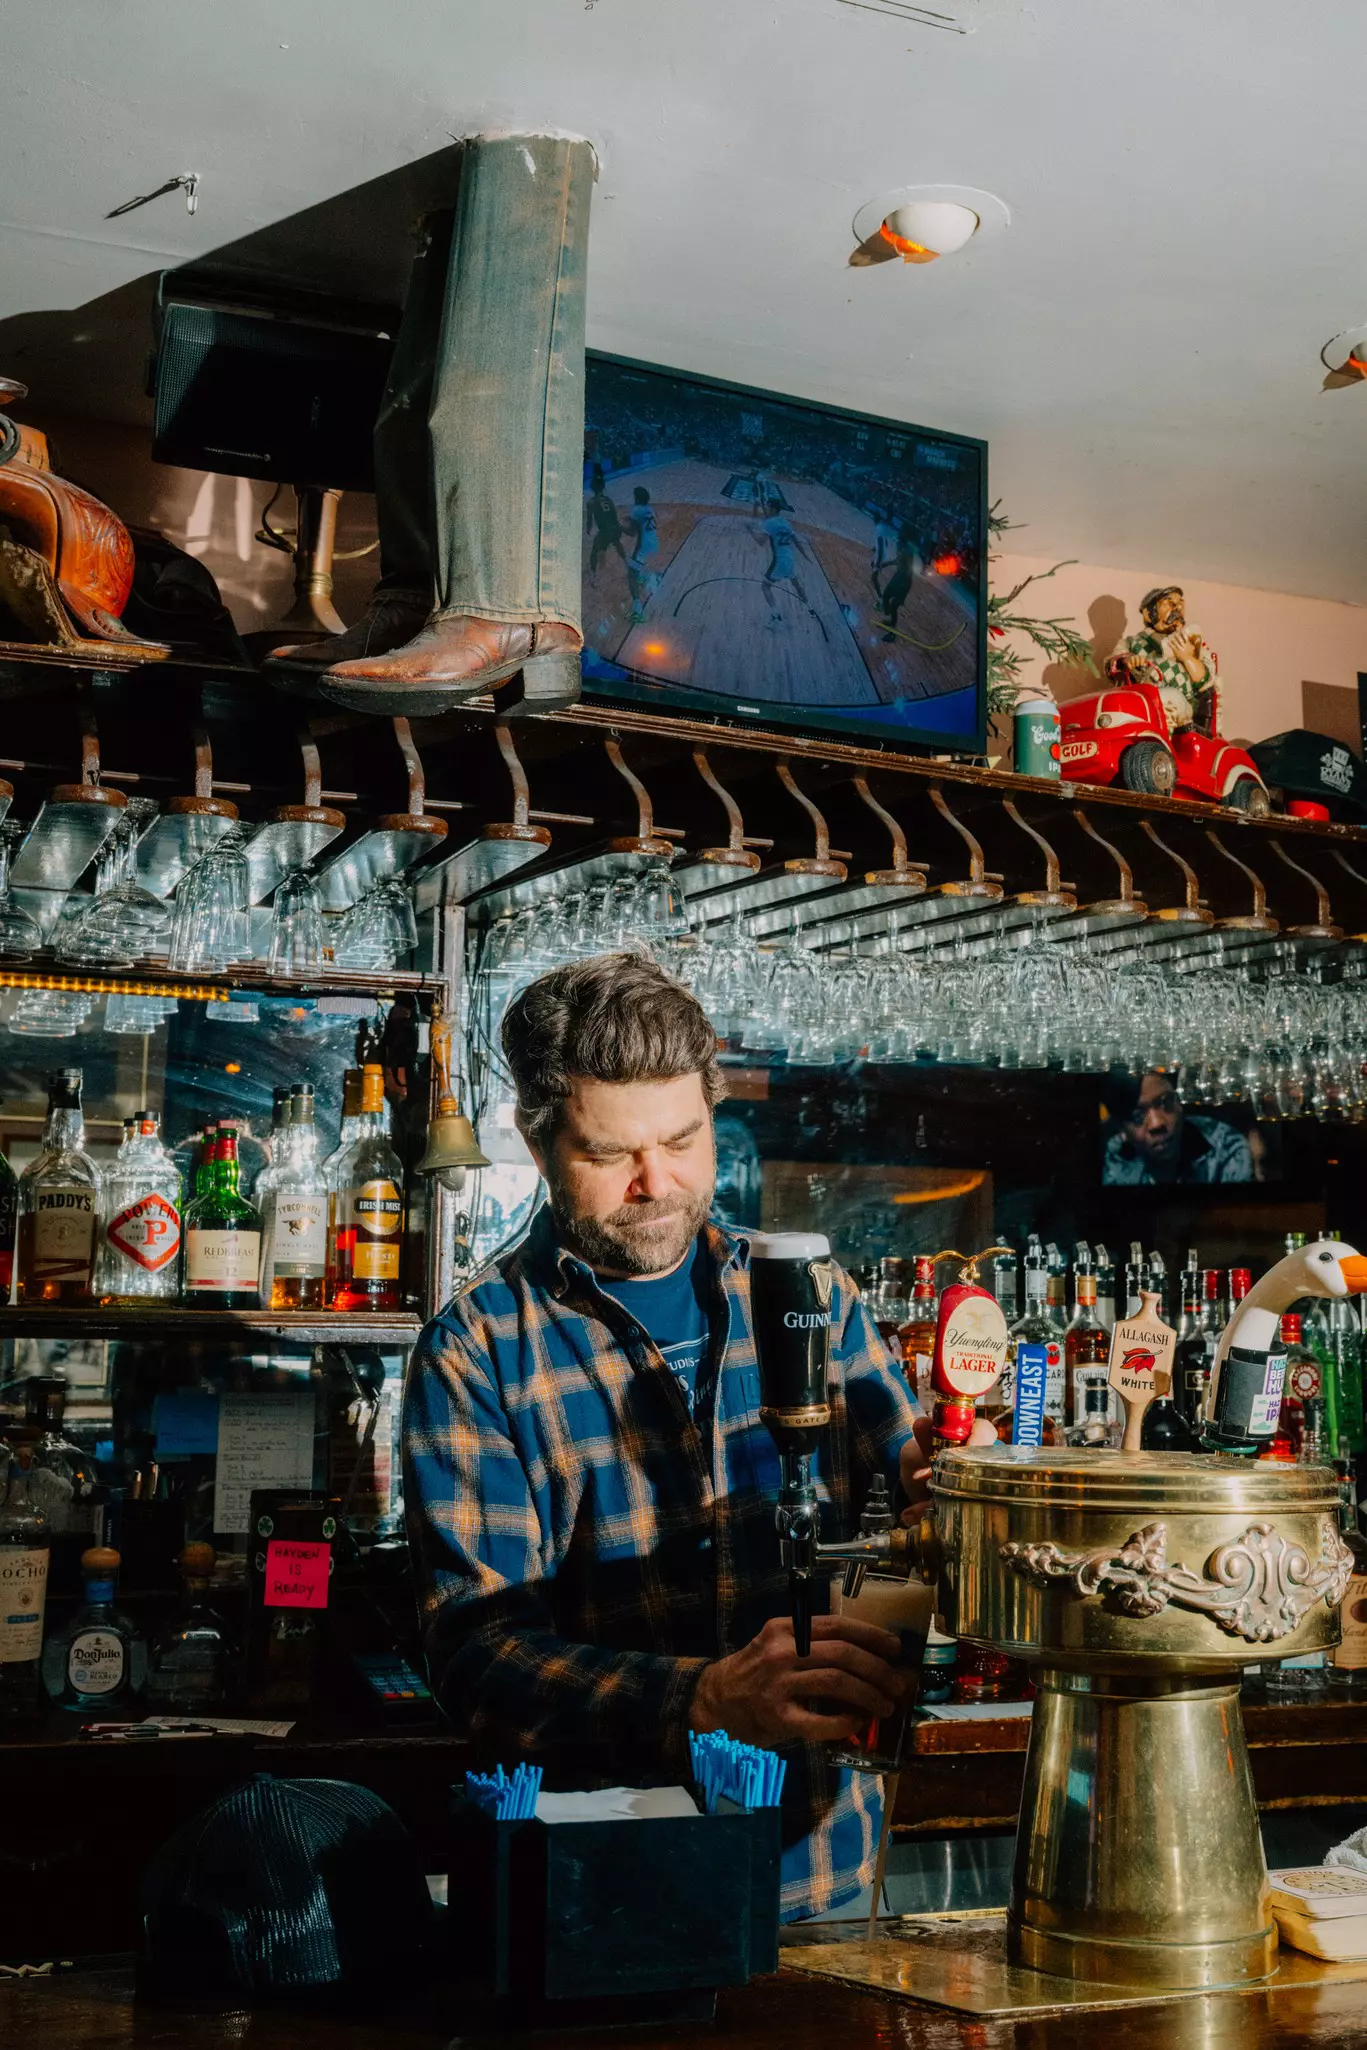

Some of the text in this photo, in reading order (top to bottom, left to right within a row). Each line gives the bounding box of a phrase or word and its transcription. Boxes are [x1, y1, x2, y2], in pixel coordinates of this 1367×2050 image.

[1062, 743, 1093, 757] GOLF
[39, 1193, 91, 1212] PADDY'S
[278, 1203, 321, 1216] TYRCONNELL
[359, 1201, 384, 1210] IRISH
[143, 1220, 167, 1245] P
[225, 1266, 237, 1277] 12
[945, 1329, 1004, 1352] Yuengling
[1119, 1327, 1169, 1346] ALLAGASH
[950, 1357, 996, 1374] LAGER
[1121, 1377, 1155, 1390] WHITE
[3, 1567, 45, 1578] OCHO
[289, 1562, 302, 1576] IS
